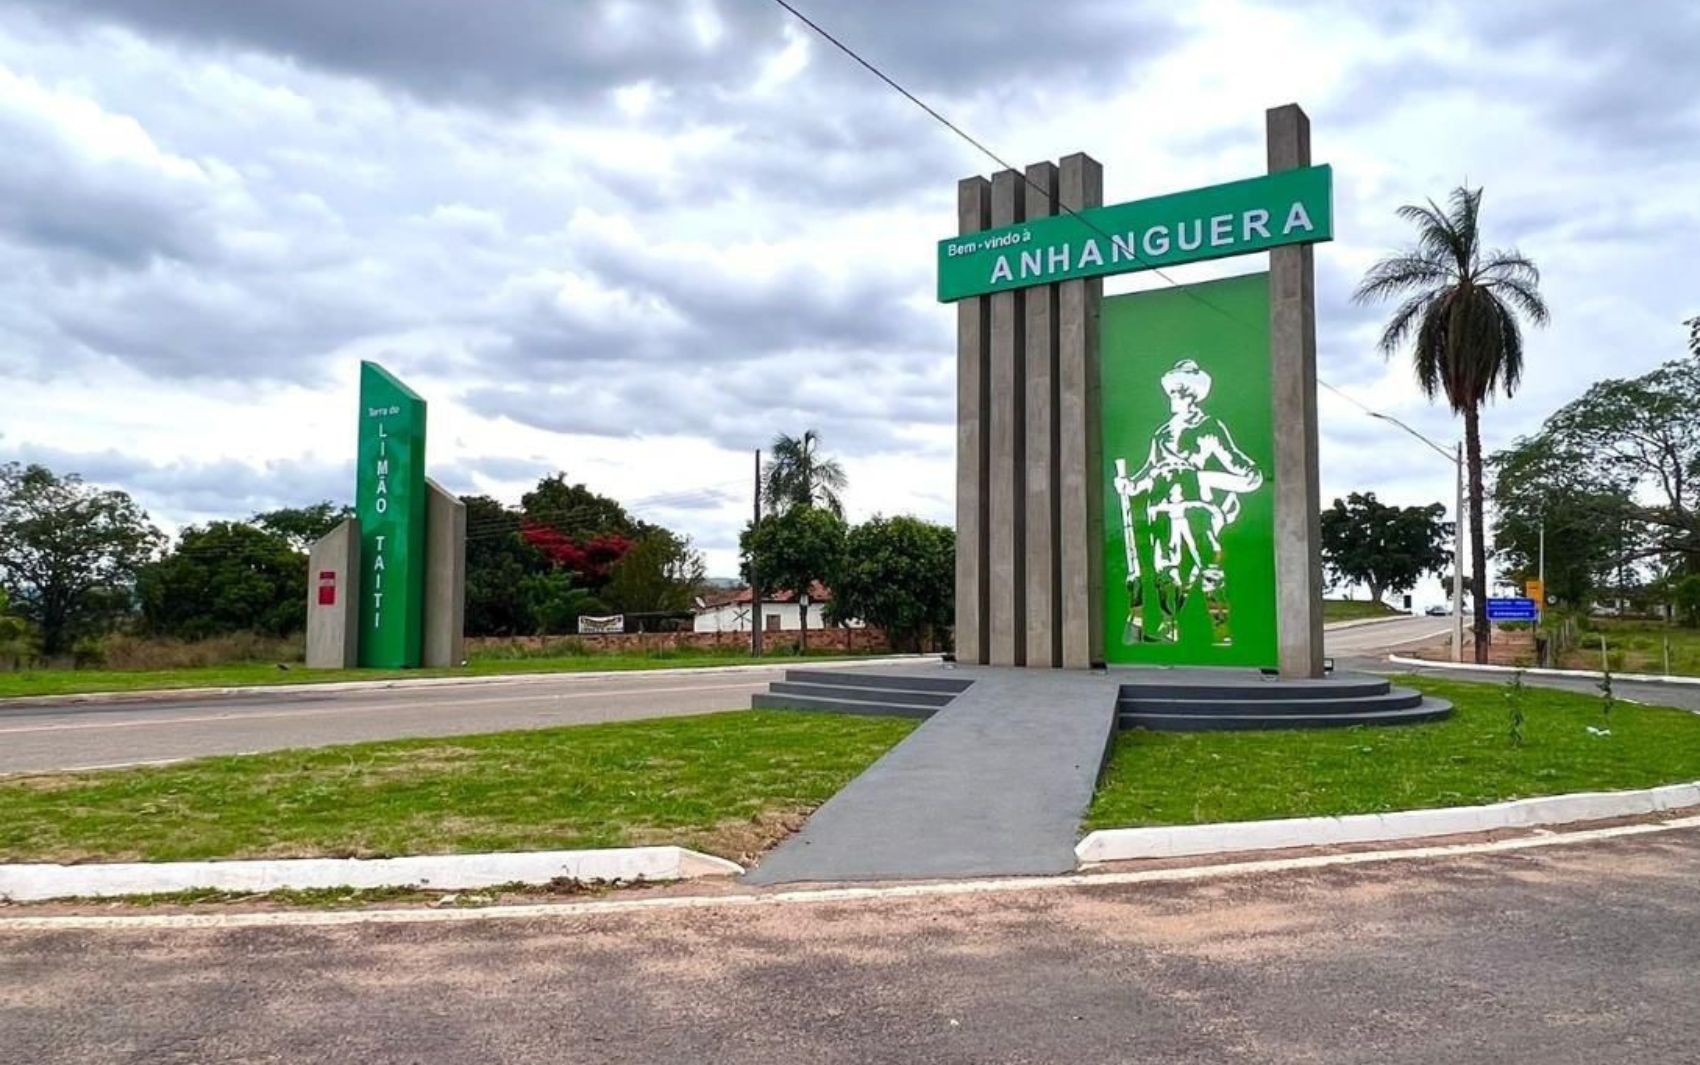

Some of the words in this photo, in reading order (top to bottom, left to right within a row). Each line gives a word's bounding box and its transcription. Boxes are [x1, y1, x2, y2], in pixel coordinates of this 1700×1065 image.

[990, 201, 1314, 284] ANHANGUERA
[375, 422, 389, 514] LIMÃO
[374, 535, 386, 629] TAITI
